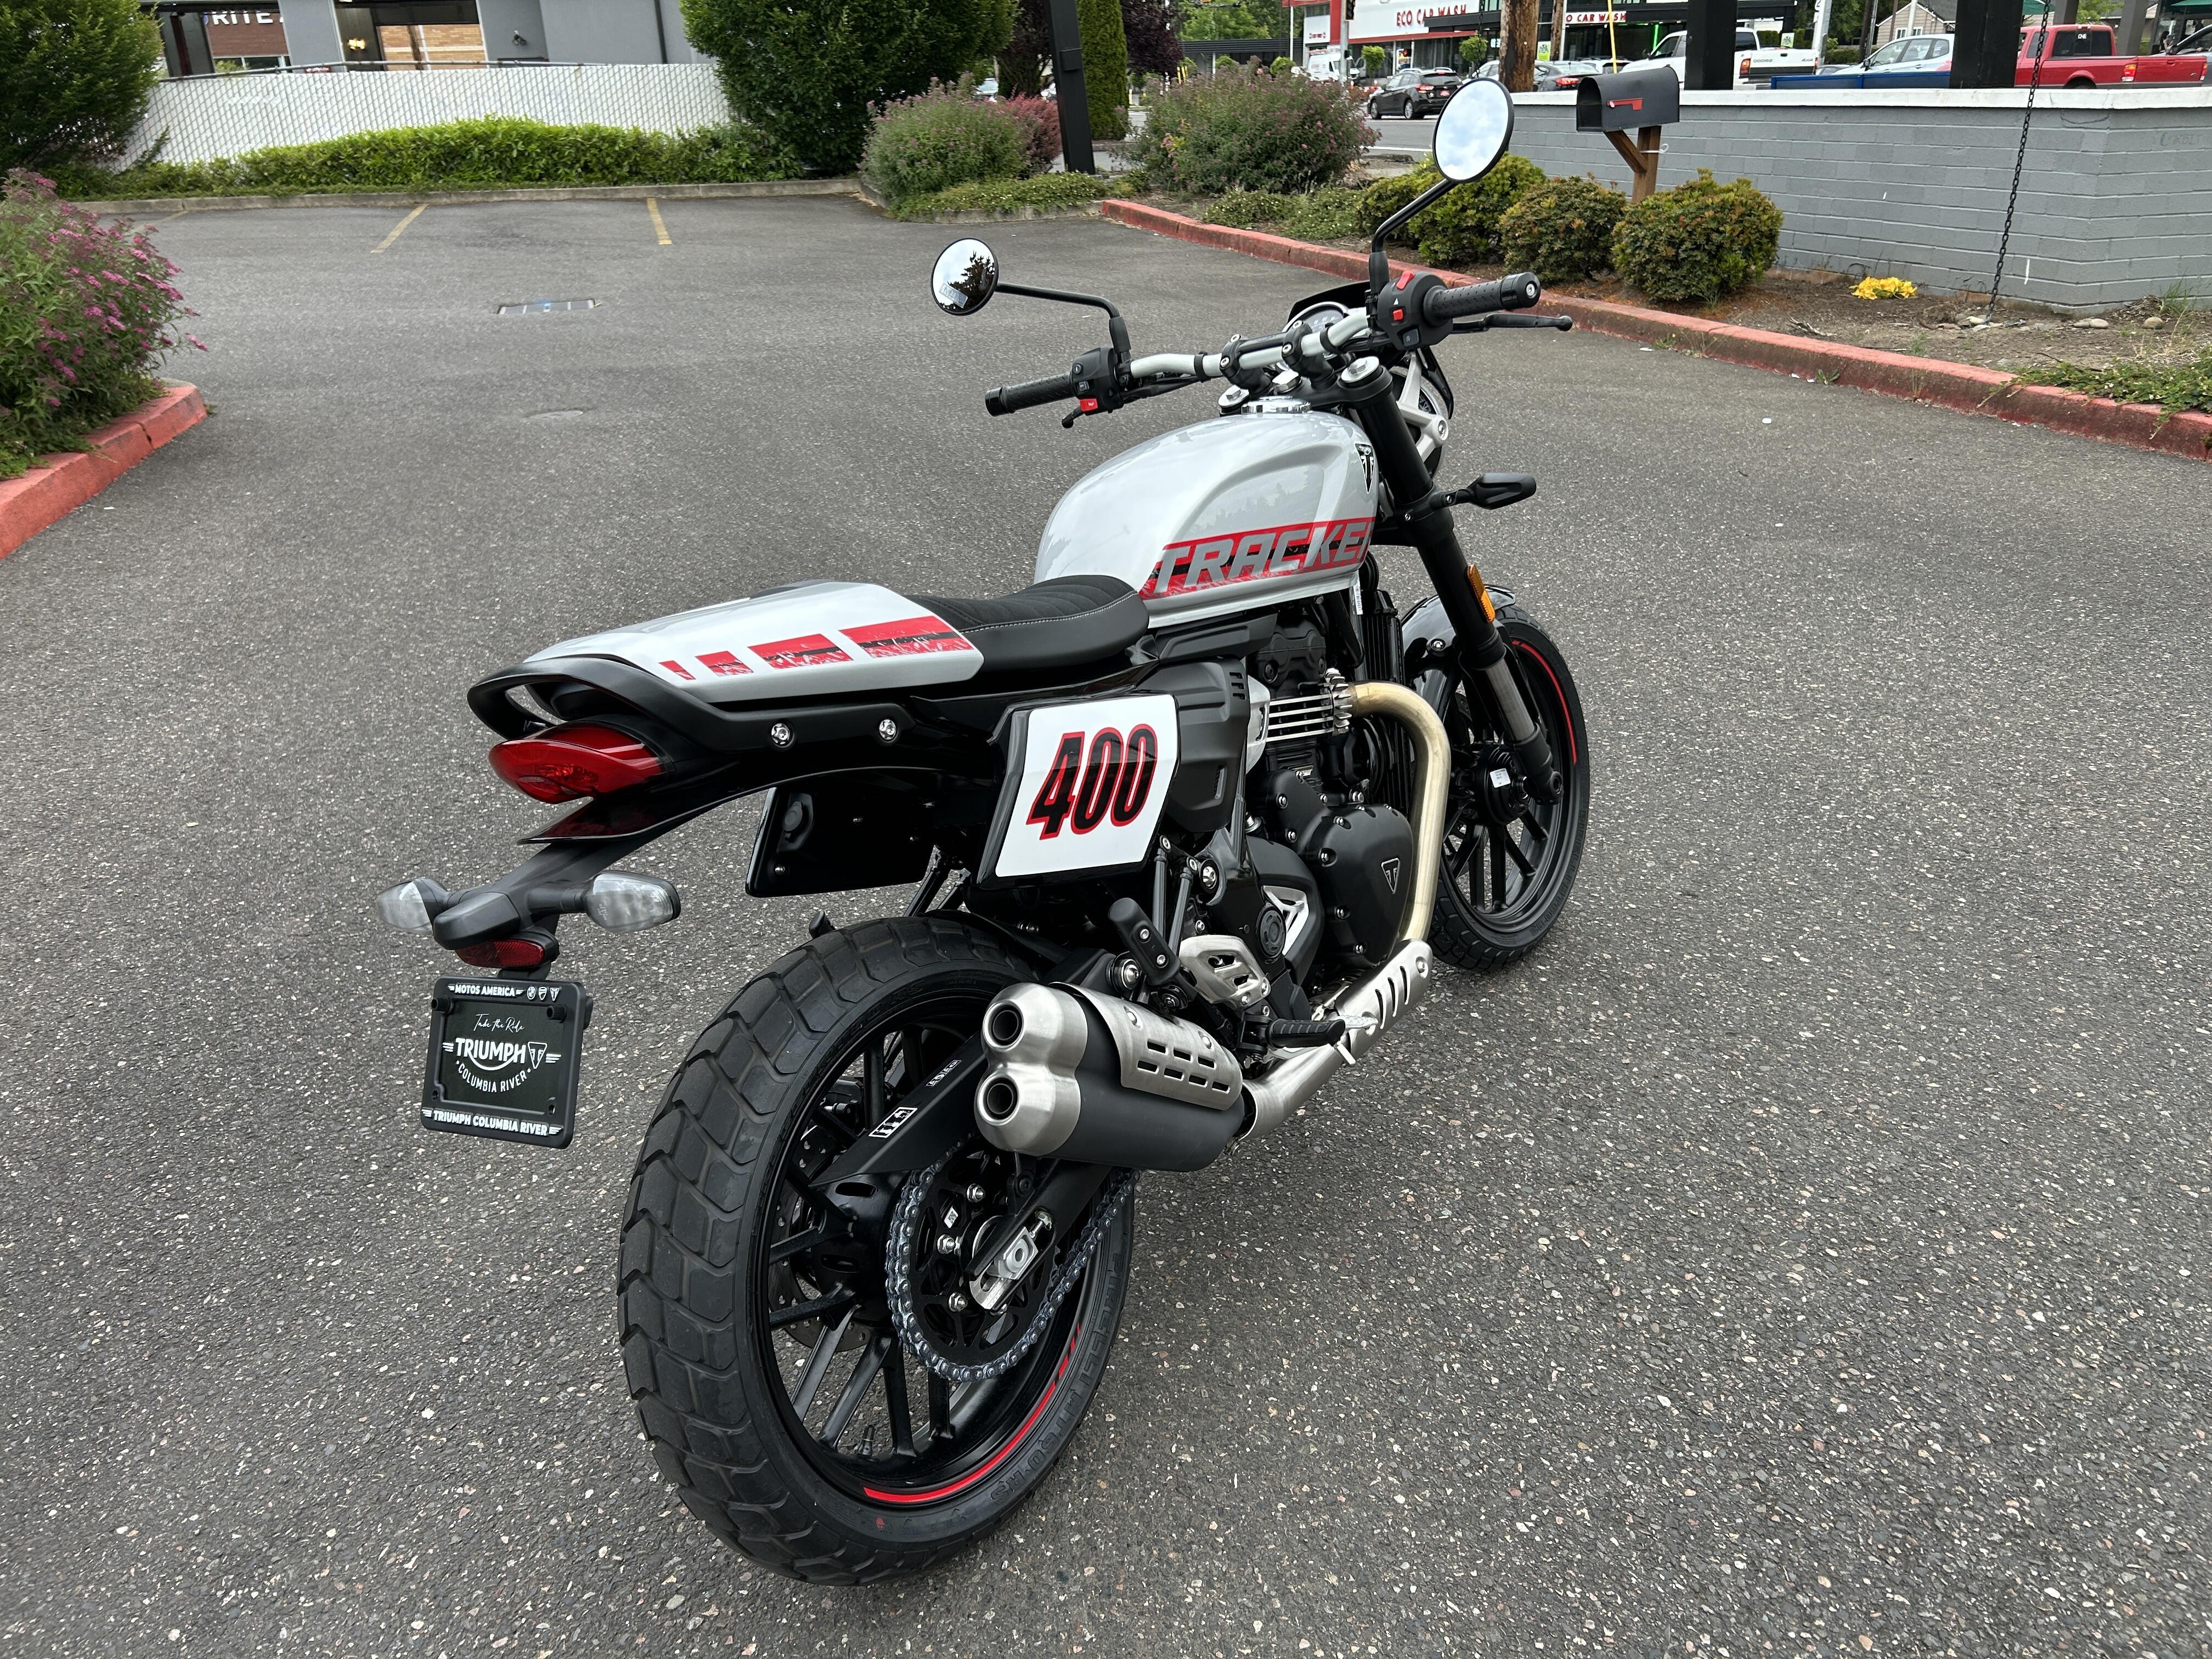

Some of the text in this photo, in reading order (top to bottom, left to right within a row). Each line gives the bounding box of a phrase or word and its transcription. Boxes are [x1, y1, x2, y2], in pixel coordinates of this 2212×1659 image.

[1397, 4, 1466, 26] ECO CAR WASH
[1577, 14, 1594, 22] CAR
[1026, 724, 1158, 840] 400
[454, 984, 516, 997] MOTOS AMERICA
[473, 1013, 525, 1032] Take the Ride
[455, 1037, 526, 1070] TRIUMPH
[458, 1063, 527, 1093] COLUMBIA RIVER
[433, 1110, 548, 1136] TRIUMPH COLUMBIA RIVER
[1080, 1253, 1125, 1387] PIRELLI
